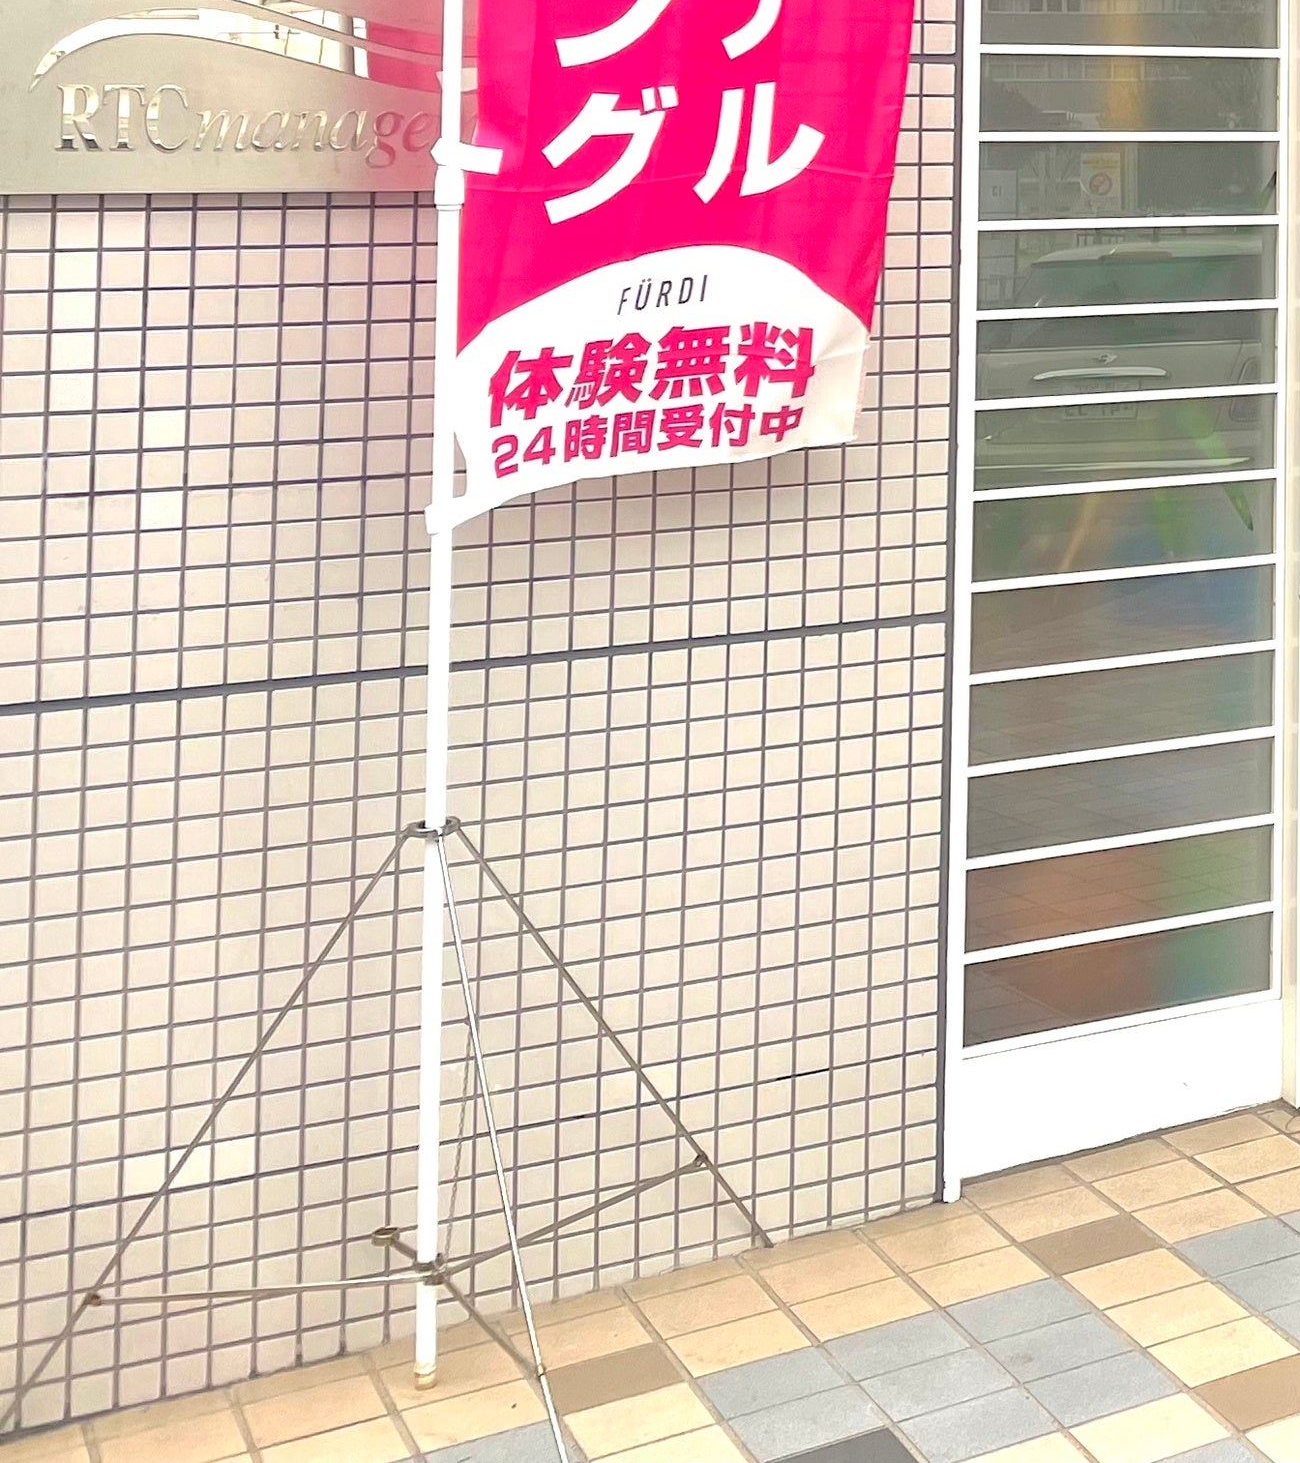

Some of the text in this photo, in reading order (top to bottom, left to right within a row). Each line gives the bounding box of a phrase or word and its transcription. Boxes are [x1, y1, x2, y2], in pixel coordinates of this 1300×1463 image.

[54, 83, 476, 169] RTCmanage
[616, 274, 710, 316] FÜRDI
[487, 320, 815, 428] 体験無料
[490, 401, 803, 479] 24時間受付中
